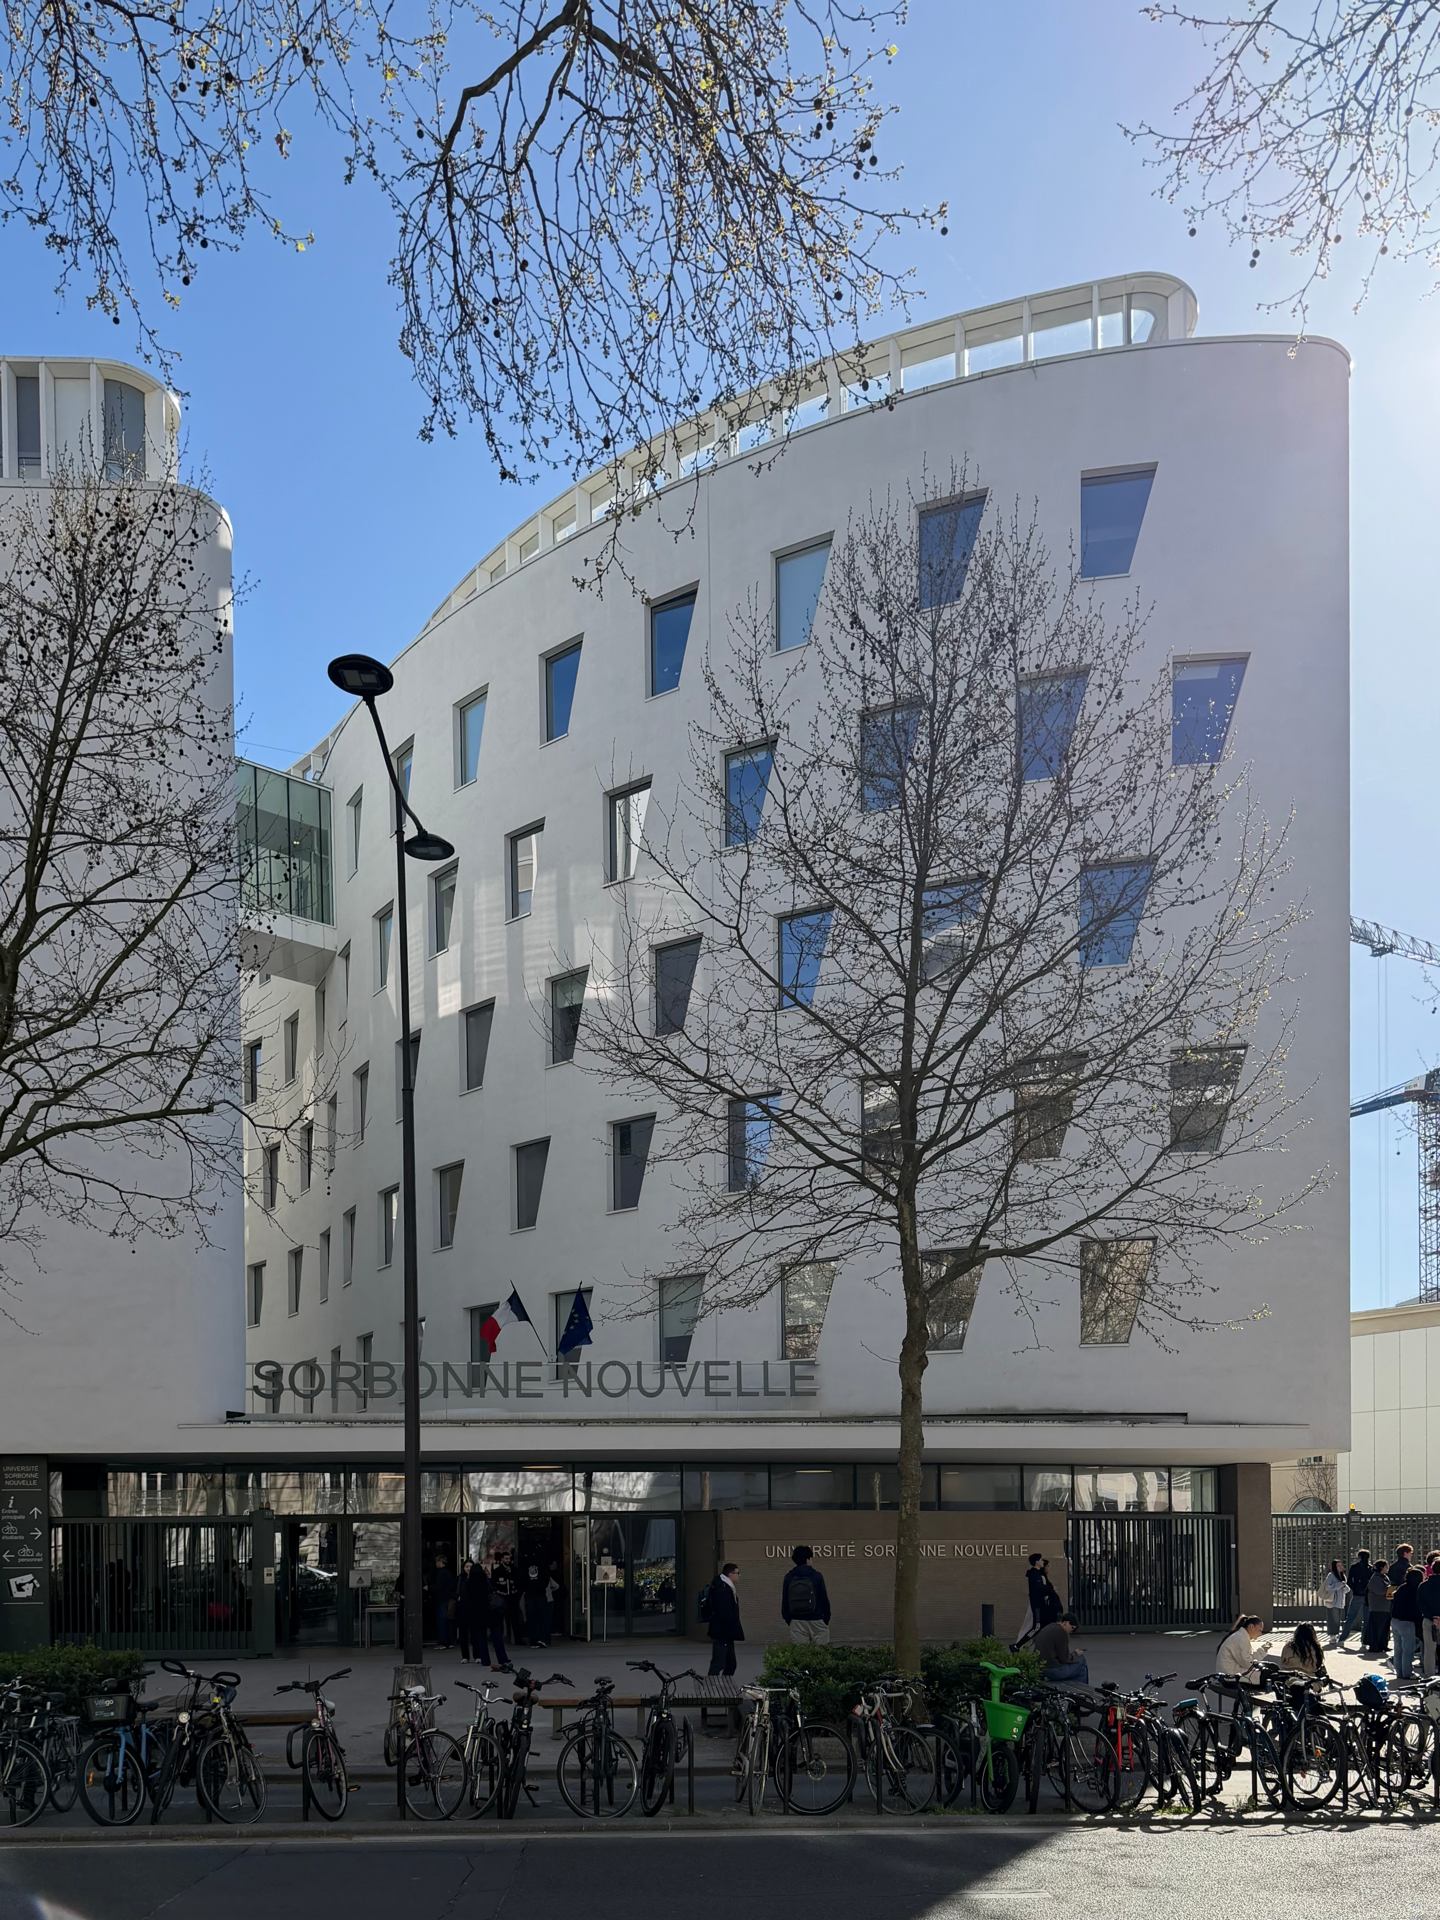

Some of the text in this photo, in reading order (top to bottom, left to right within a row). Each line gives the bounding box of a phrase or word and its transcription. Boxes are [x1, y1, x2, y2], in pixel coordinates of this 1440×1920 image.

[253, 1360, 817, 1399] SORBONNE NOUVELLE
[765, 1541, 1029, 1558] UNIRSITÉ SORNNE NOUVELLE
